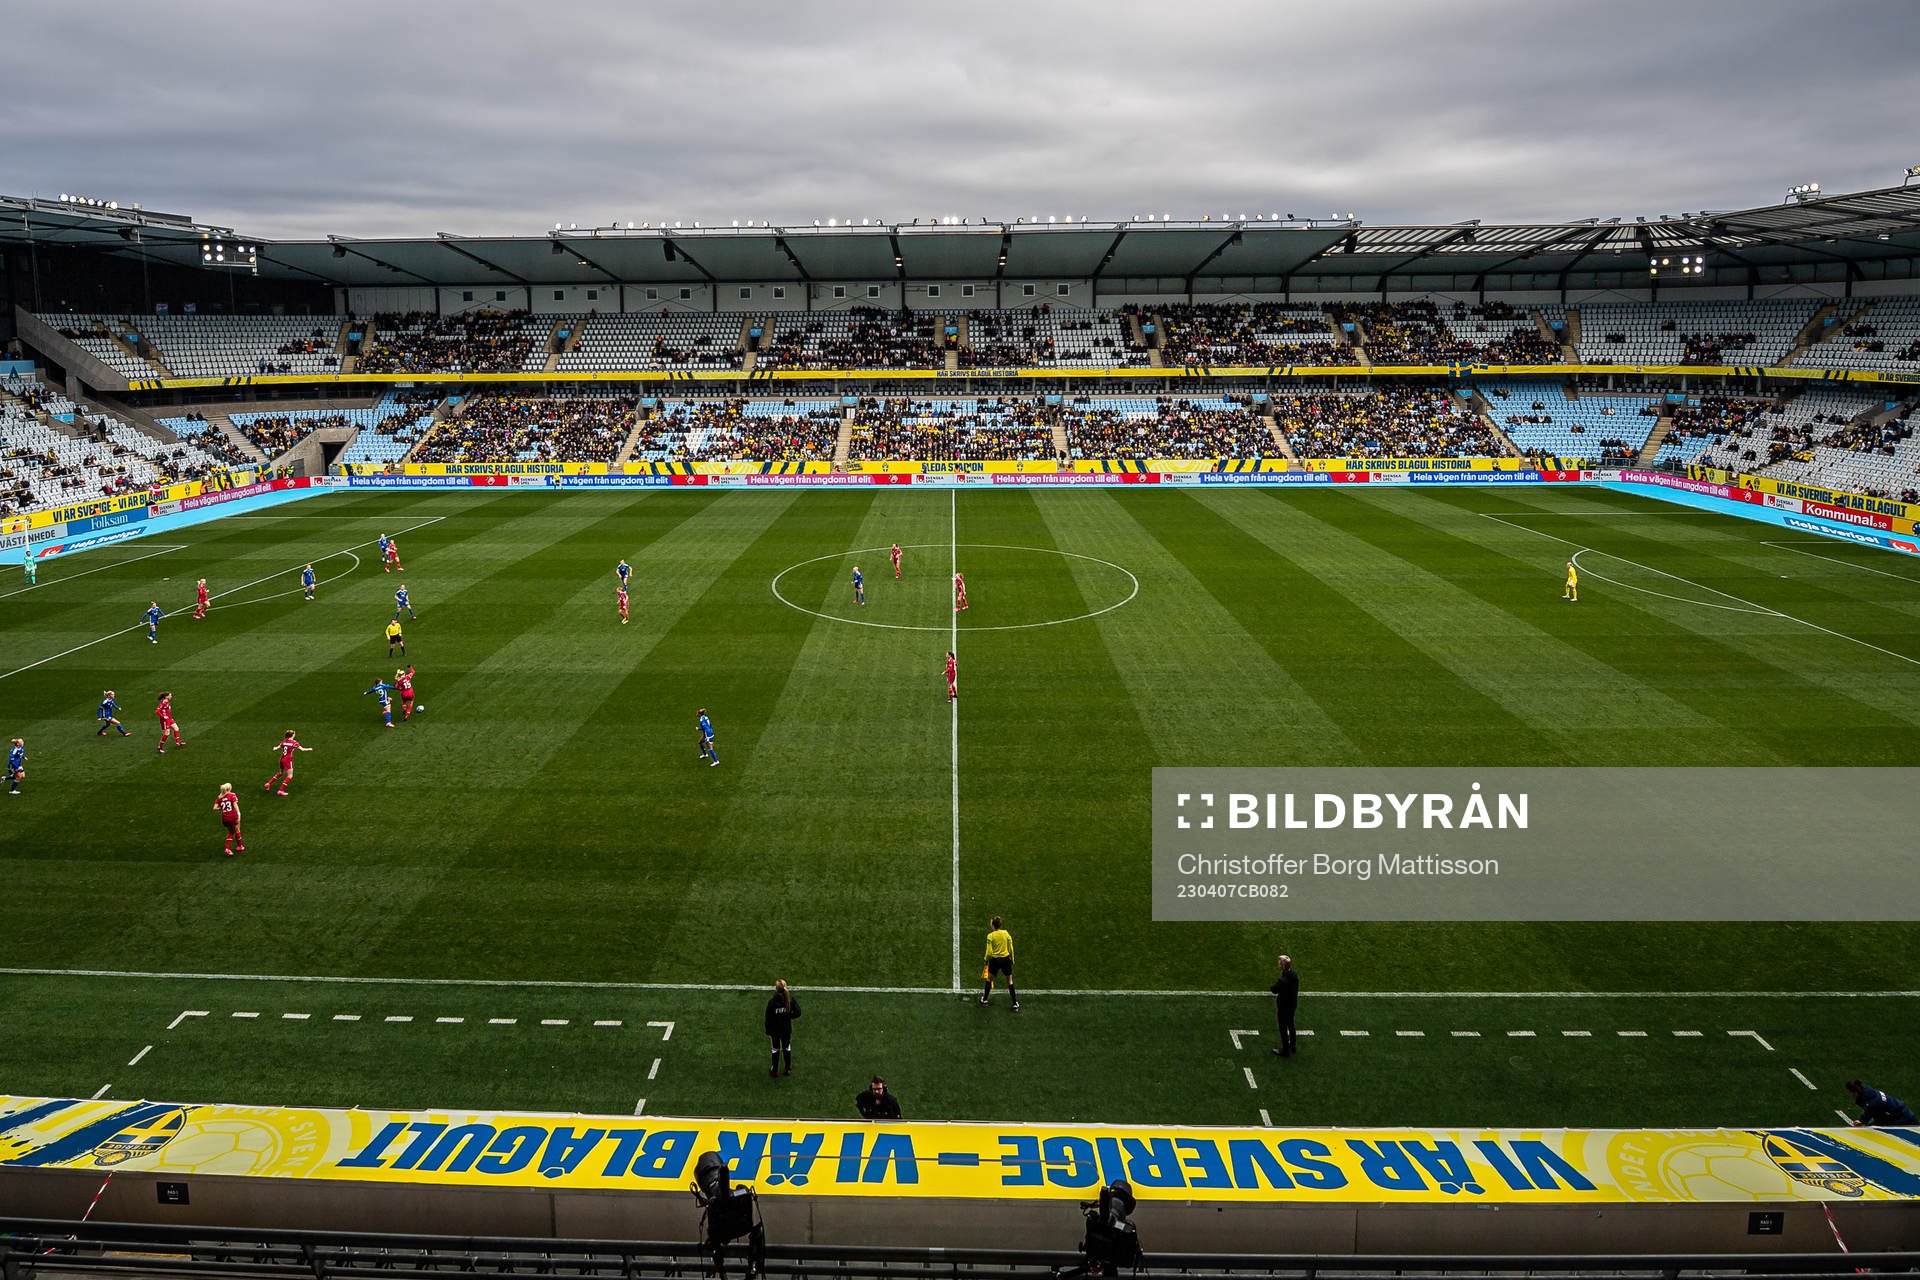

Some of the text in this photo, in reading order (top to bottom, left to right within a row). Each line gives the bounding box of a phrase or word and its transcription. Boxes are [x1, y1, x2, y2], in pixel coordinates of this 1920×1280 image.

[464, 464, 492, 474] SKRIVS
[527, 464, 564, 474] HISTORIA
[1366, 460, 1395, 469] SKRIVS
[1432, 460, 1471, 469] HISTORIA
[352, 477, 469, 487] Hela vägen från ungdom till elit
[550, 476, 668, 486] Hla vägen från ungdom till elit
[750, 476, 871, 485] Hela vägen från ungdom till elit
[996, 475, 1119, 484] Hela vägen från ungdom till elit
[1204, 474, 1328, 484] Hela vägen från ungdom till elit
[1414, 473, 1538, 482] Hela vägen från ungdom till elit
[1625, 473, 1729, 497] Hela vägen från ungdom till elit
[184, 499, 199, 509] Hela
[200, 494, 219, 507] vägen
[219, 491, 230, 501] från
[231, 488, 255, 501] ungdom
[263, 484, 271, 492] elit
[1776, 482, 1785, 494] VI
[1786, 483, 1798, 497] ÄR
[1800, 486, 1833, 503] SVERIGE
[53, 511, 62, 523] VI
[64, 508, 76, 520] ÄR
[118, 499, 126, 510] VI
[128, 495, 138, 508] ÄR
[91, 514, 129, 530] Folksam
[221, 801, 232, 812] 23
[335, 1122, 698, 1179] BLÅGULT
[718, 1131, 823, 1186] ÄR
[836, 1133, 919, 1184] VI
[998, 1134, 1350, 1190] SVERIGE
[1346, 1138, 1486, 1195] ÄR
[1475, 1140, 1598, 1191] VI
